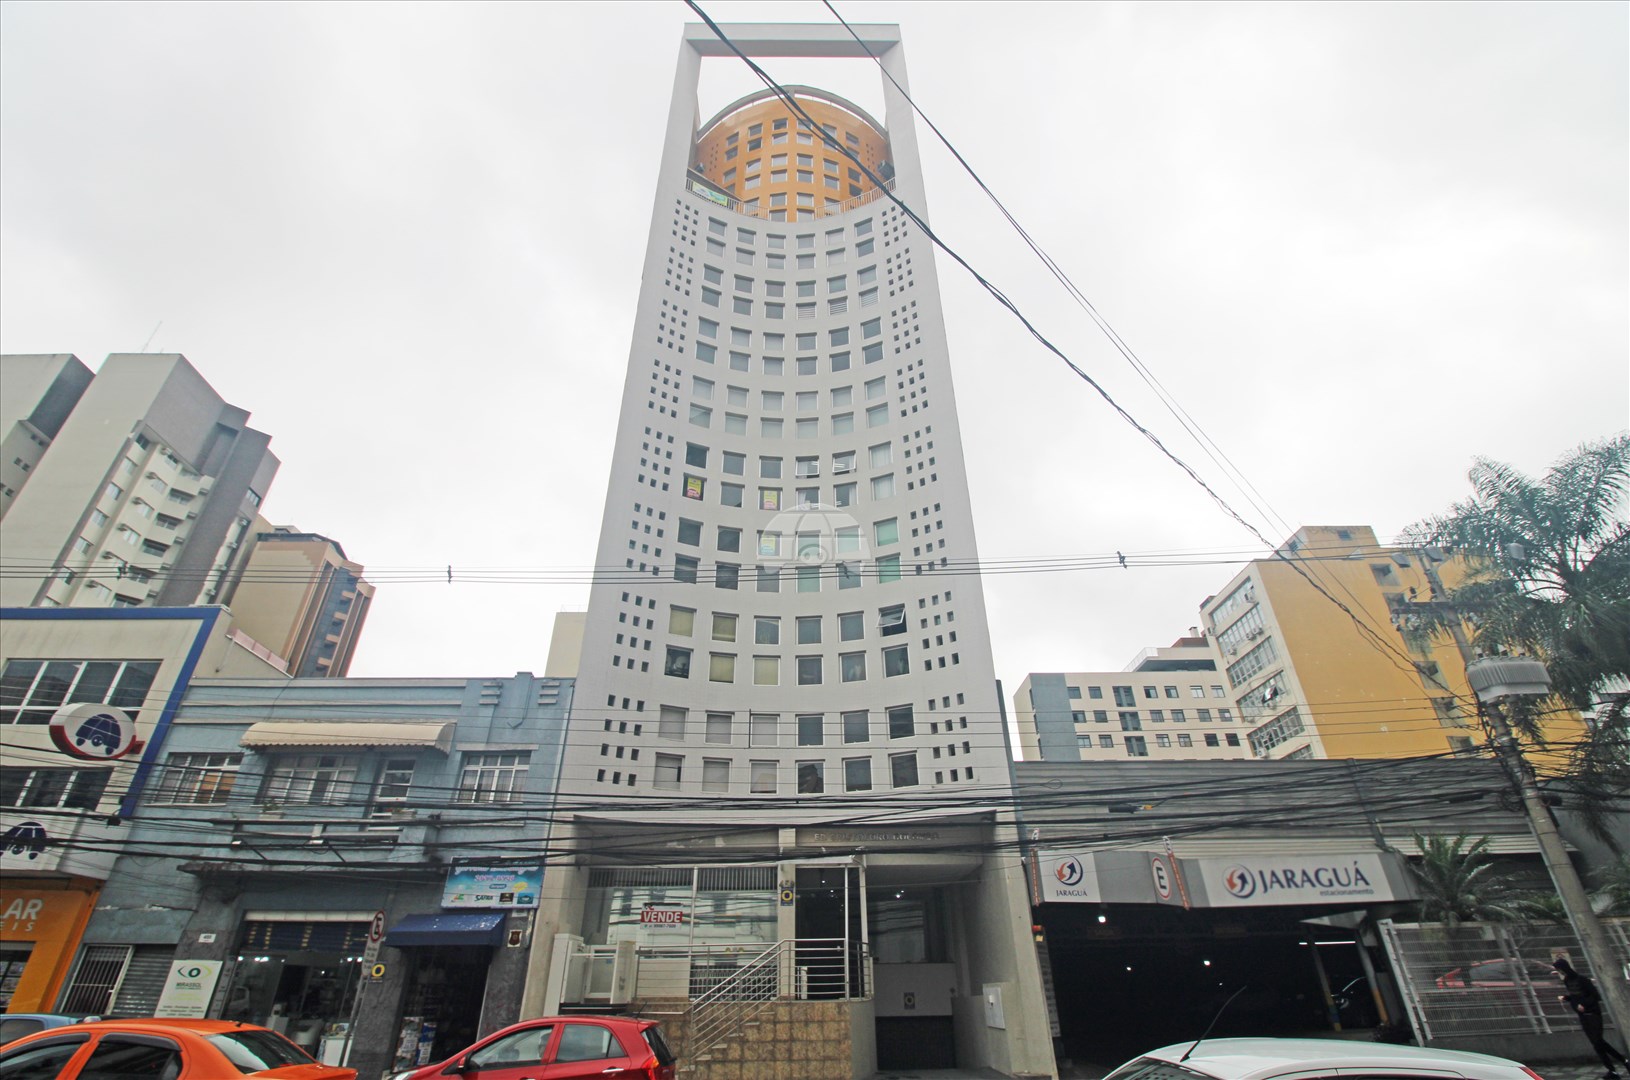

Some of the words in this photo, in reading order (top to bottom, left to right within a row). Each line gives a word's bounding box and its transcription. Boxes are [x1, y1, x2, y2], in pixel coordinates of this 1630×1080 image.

[1155, 866, 1167, 890] E
[1258, 861, 1370, 894] JARAGUÁ
[1319, 888, 1375, 897] estacionamento
[0, 898, 43, 920] AR
[643, 911, 681, 923] VENDE
